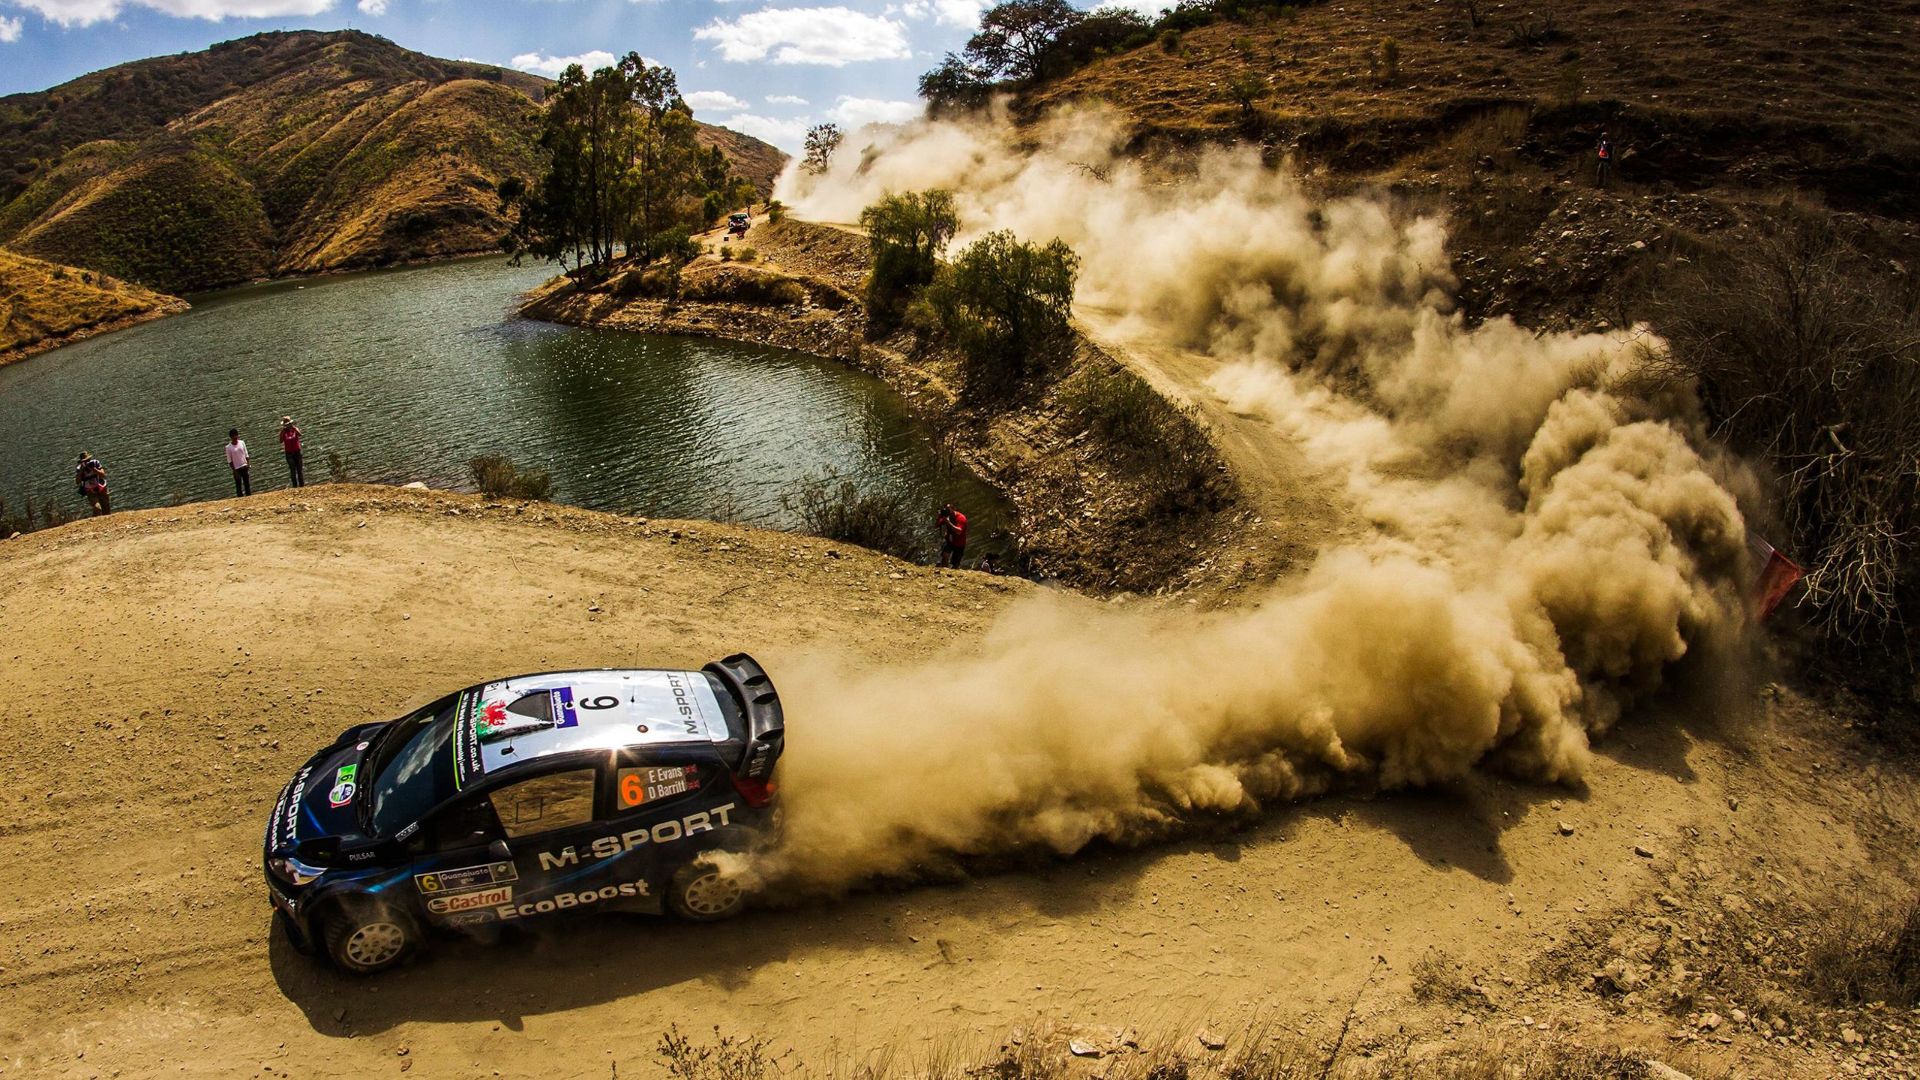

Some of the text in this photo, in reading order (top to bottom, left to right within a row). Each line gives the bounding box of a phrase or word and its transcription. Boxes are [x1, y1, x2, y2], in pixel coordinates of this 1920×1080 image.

[580, 696, 619, 710] 6
[648, 767, 683, 783] E Evans
[621, 774, 644, 806] 6
[648, 780, 686, 799] D Barritt
[422, 875, 438, 891] 6
[449, 889, 508, 910] Castrol
[496, 878, 650, 920] EcoBoost
